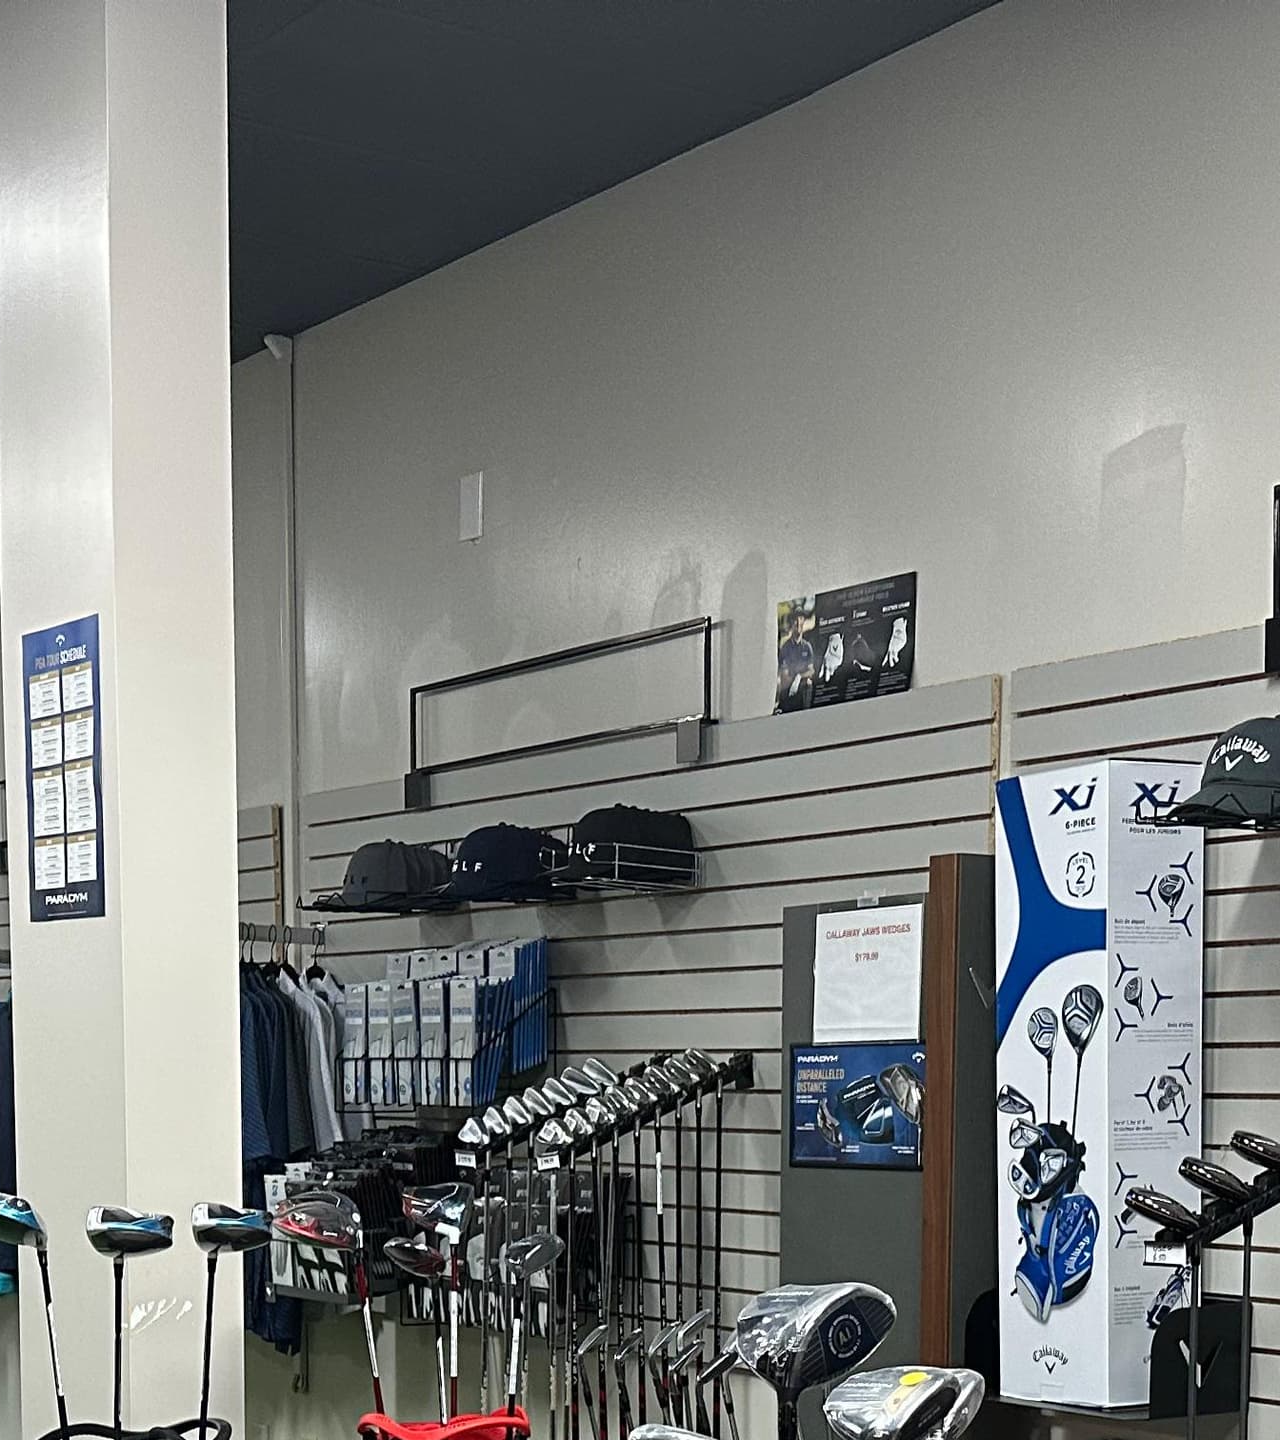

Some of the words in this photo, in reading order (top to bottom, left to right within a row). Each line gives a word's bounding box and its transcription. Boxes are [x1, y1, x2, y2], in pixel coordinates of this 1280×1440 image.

[1211, 736, 1271, 765] Callaway
[1065, 817, 1097, 830] 6-PIECE
[1157, 827, 1182, 836] JUNIORS
[1076, 865, 1086, 885] 2
[45, 892, 88, 906] PARADYM
[826, 928, 860, 940] CALLAWAY
[862, 926, 880, 937] JAWS
[882, 923, 911, 935] WEDGES
[797, 1054, 839, 1064] PARADYM
[797, 1068, 845, 1081] UNPARALLELED
[796, 1081, 827, 1093] DISTANCE
[1033, 1345, 1068, 1366] Callaway
